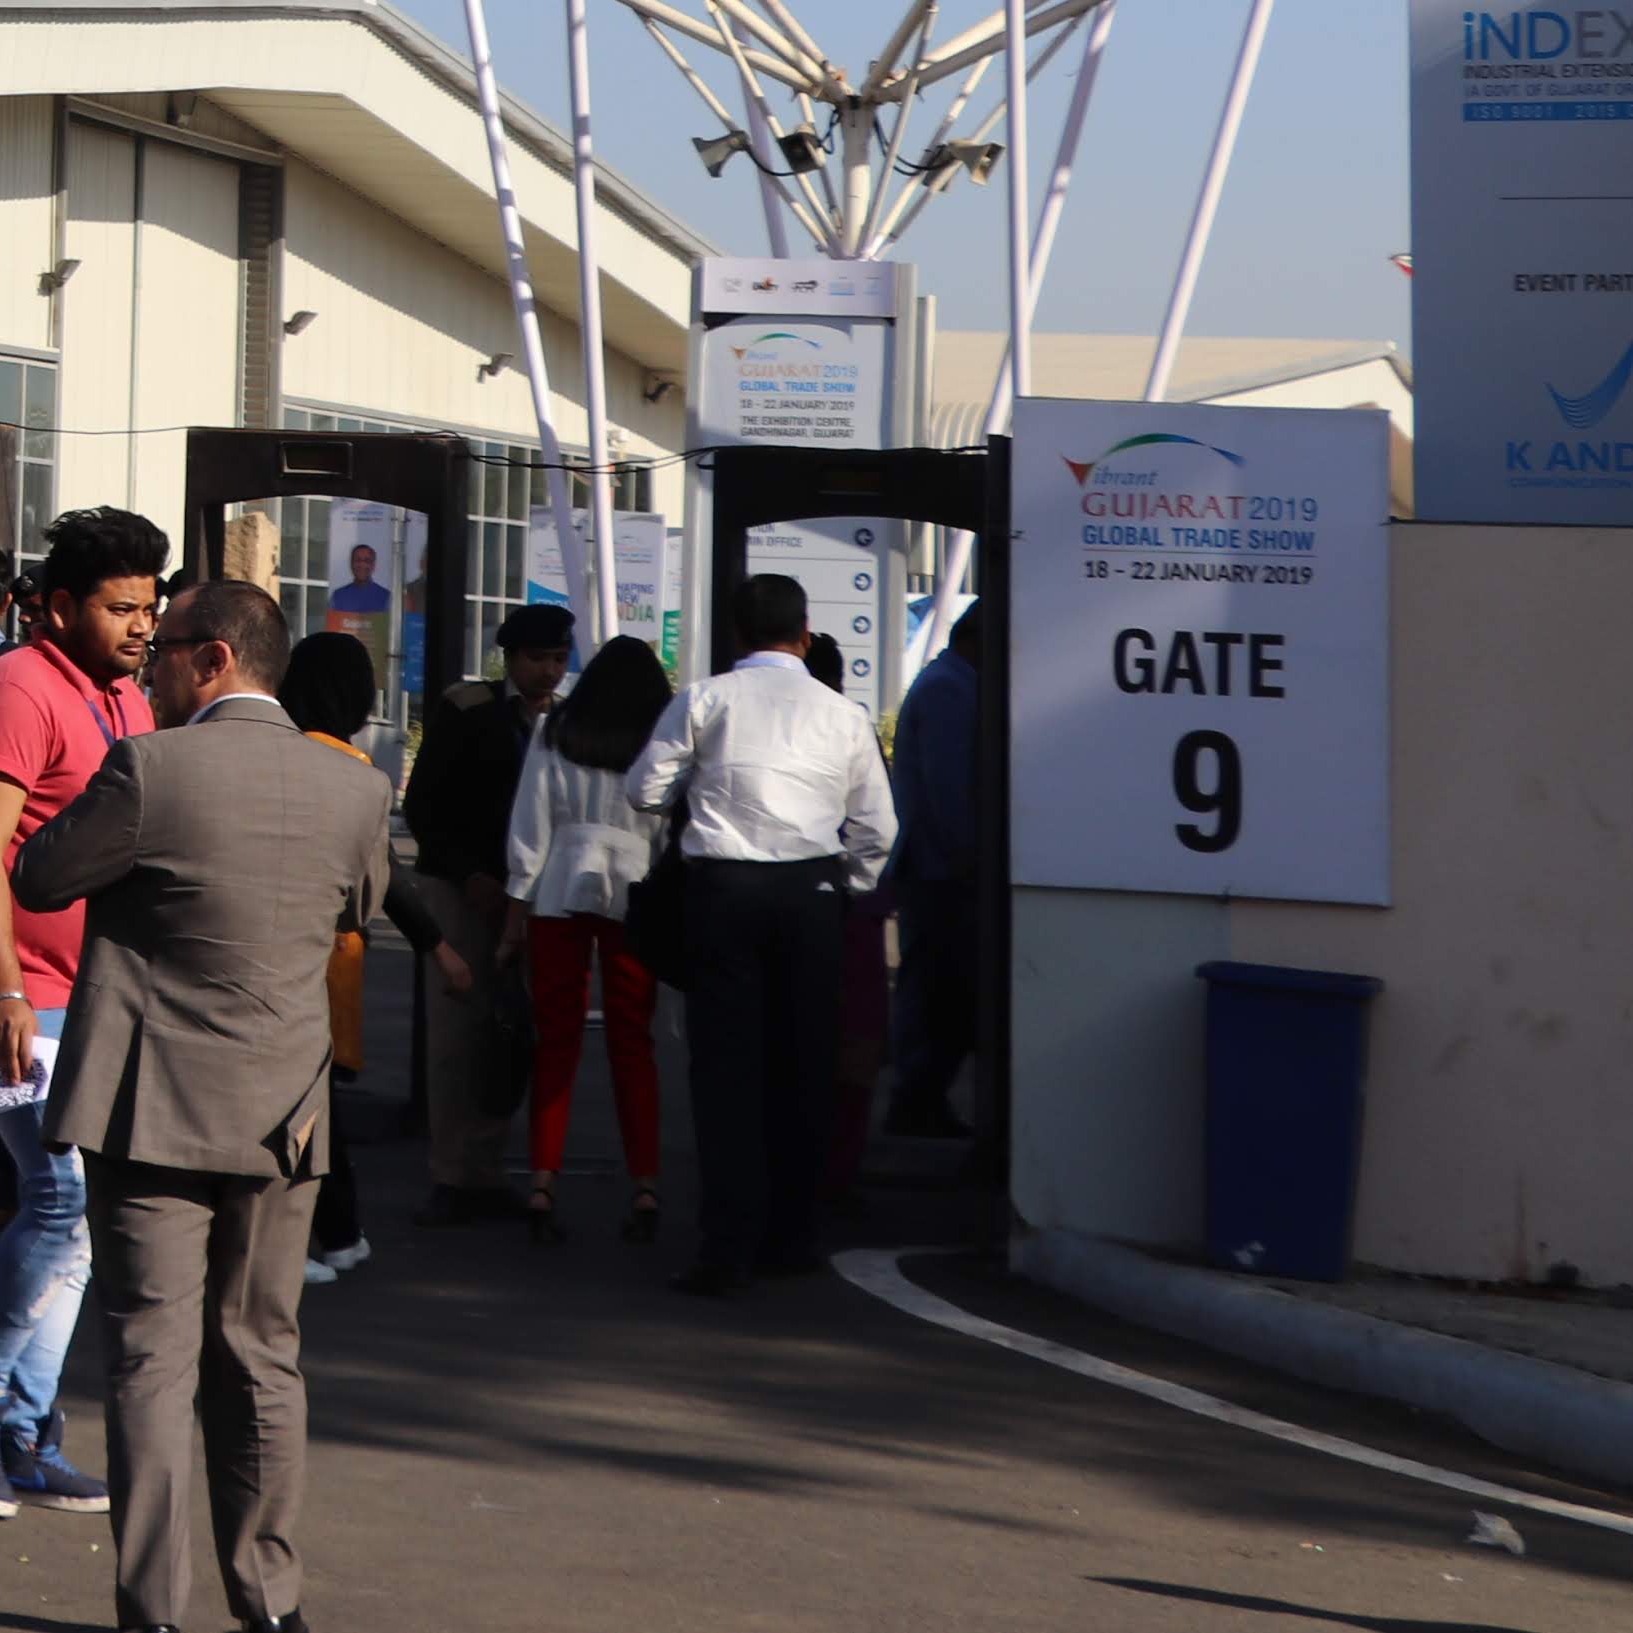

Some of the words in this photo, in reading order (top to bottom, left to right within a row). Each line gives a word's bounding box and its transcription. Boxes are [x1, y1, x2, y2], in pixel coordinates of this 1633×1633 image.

[1463, 11, 1633, 61] iNDEX
[1514, 273, 1578, 292] EVENT
[1584, 274, 1633, 292] PART
[739, 381, 780, 392] GLOBAL
[785, 382, 818, 392] TRADE
[823, 382, 856, 393] SHOW
[763, 400, 777, 410] 22
[778, 399, 827, 410] JANUARY
[830, 400, 855, 411] 2019
[1506, 441, 1531, 471] K
[1081, 492, 1245, 520] GUJARAT
[1248, 496, 1318, 522] 2019
[1082, 524, 1163, 546] GLOBAL
[1172, 527, 1242, 549] TRADE
[1248, 529, 1315, 551] SHOW
[1085, 560, 1109, 579] 18
[1131, 561, 1154, 580] 22
[1159, 562, 1257, 583] JANUARY
[1262, 566, 1313, 585] 2019
[616, 583, 656, 595] HAPING
[617, 604, 655, 622] NDIA
[1113, 628, 1286, 699] GATE
[1171, 729, 1243, 853] 9
